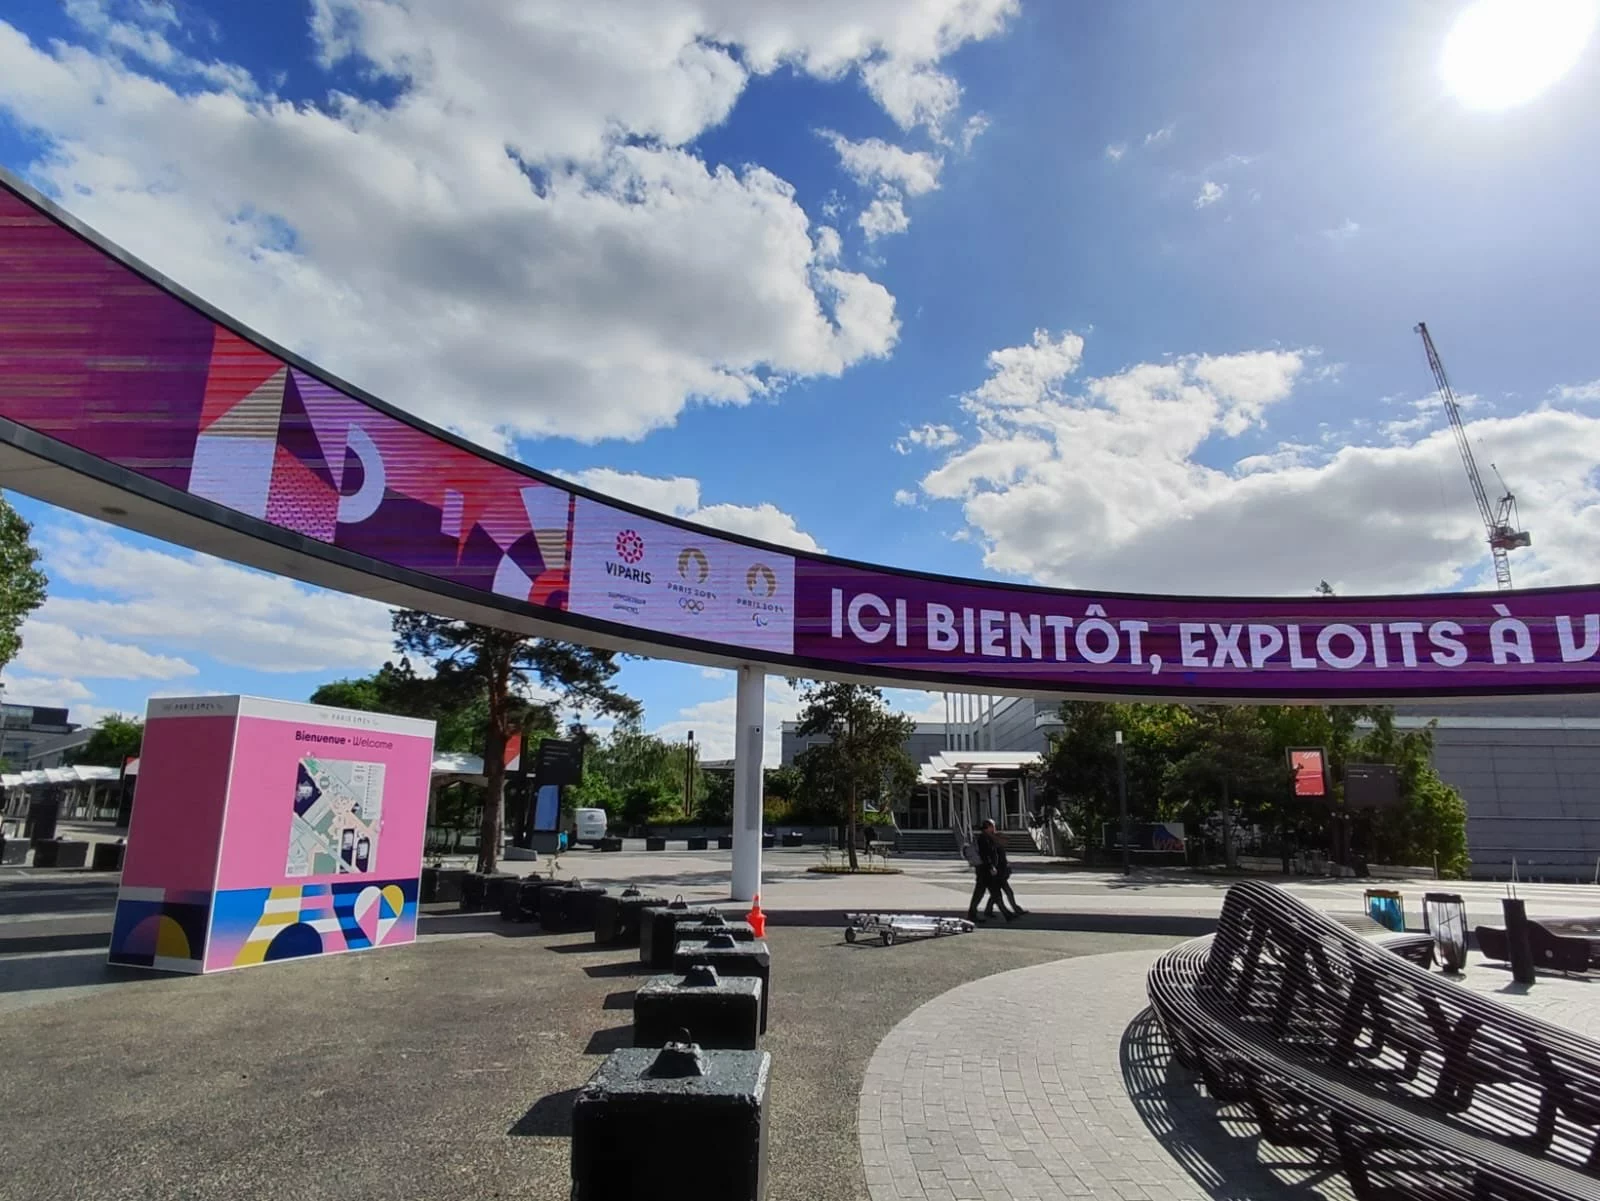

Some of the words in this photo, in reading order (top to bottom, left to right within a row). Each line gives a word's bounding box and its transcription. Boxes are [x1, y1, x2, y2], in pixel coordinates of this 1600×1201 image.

[606, 561, 652, 585] VIPARIS
[667, 582, 693, 595] PARIS
[831, 588, 907, 647] ICI
[927, 603, 1162, 675] BIENTÔT,
[1179, 621, 1468, 669] EXPLOITS
[1489, 604, 1535, 664] À
[295, 730, 346, 745] Bienvenue
[353, 736, 393, 750] Welcome
